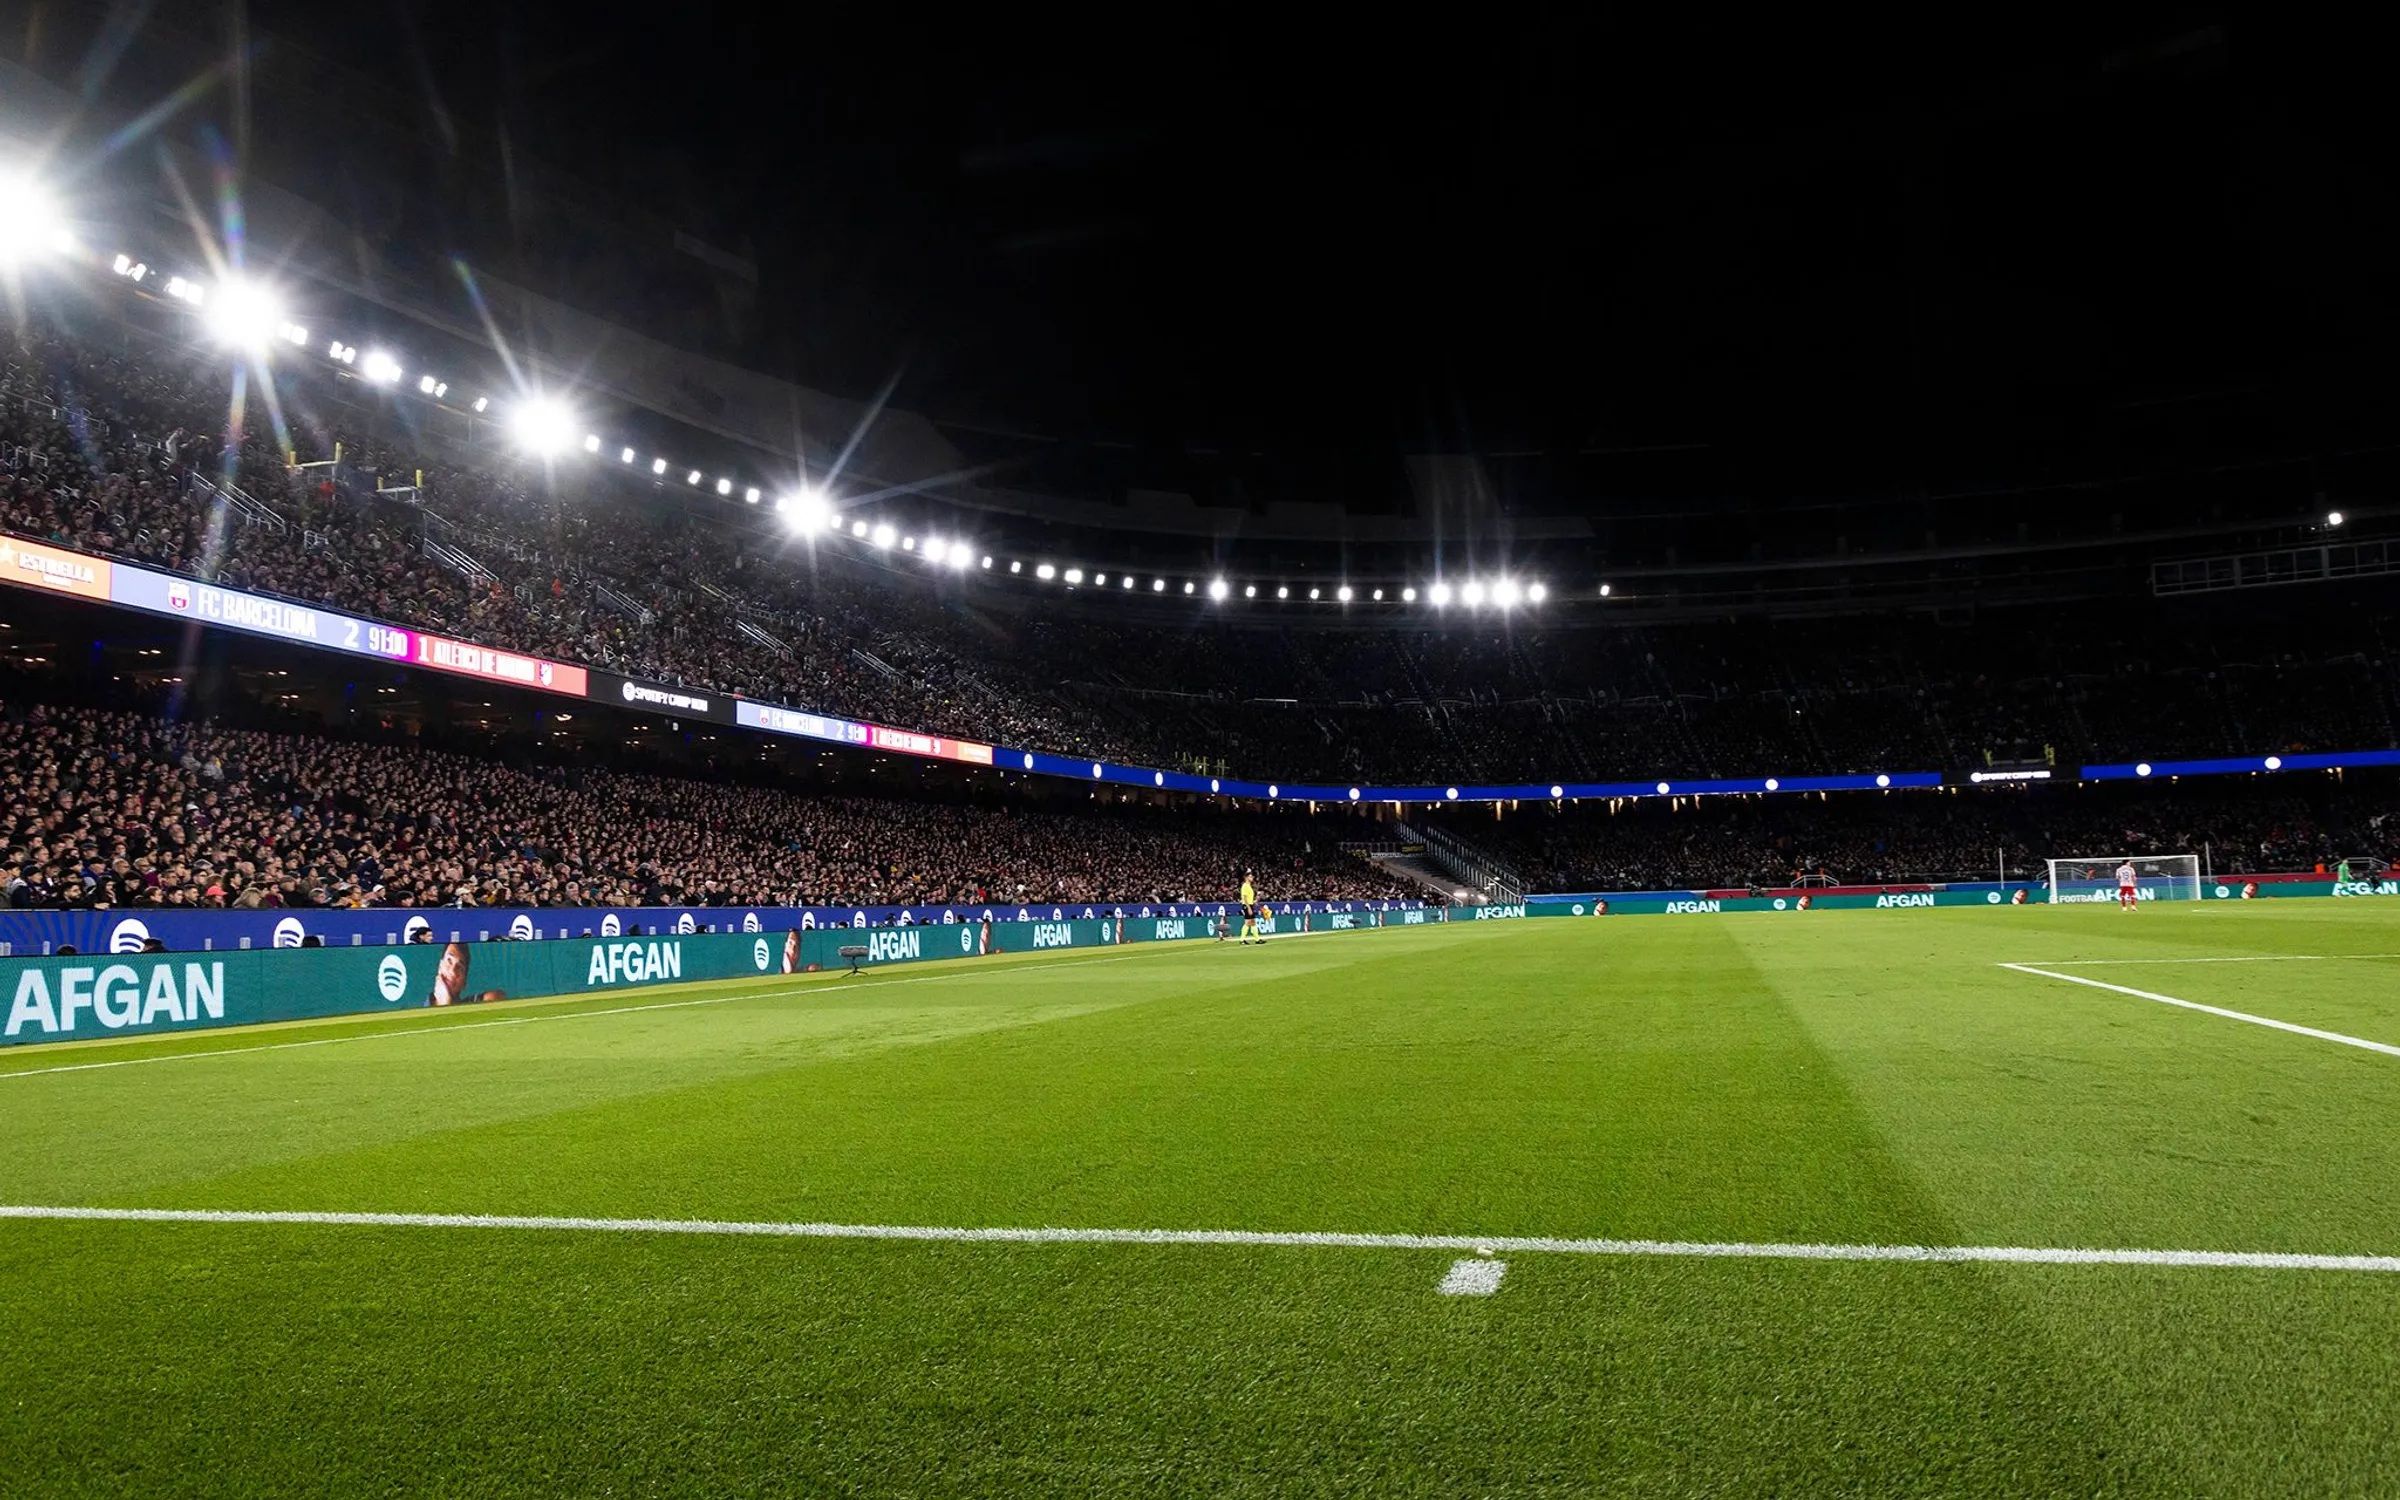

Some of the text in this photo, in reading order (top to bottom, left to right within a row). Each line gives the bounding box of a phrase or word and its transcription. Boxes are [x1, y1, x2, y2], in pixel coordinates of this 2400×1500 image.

[198, 586, 317, 638] FC BARCELONA
[343, 620, 359, 648] 2
[368, 626, 408, 657] 91:00
[418, 636, 430, 662] 1
[1475, 905, 1525, 920] AFGAN
[1666, 900, 1720, 913] AFGAN
[1876, 894, 1934, 908] AFGAN
[1033, 923, 1071, 948] AFGAN
[1156, 920, 1185, 939] AFGAN
[1254, 917, 1276, 933] FGAN
[868, 931, 920, 961] AFGAN
[587, 941, 681, 985] AFGAN
[5, 962, 224, 1036] AFGAN
